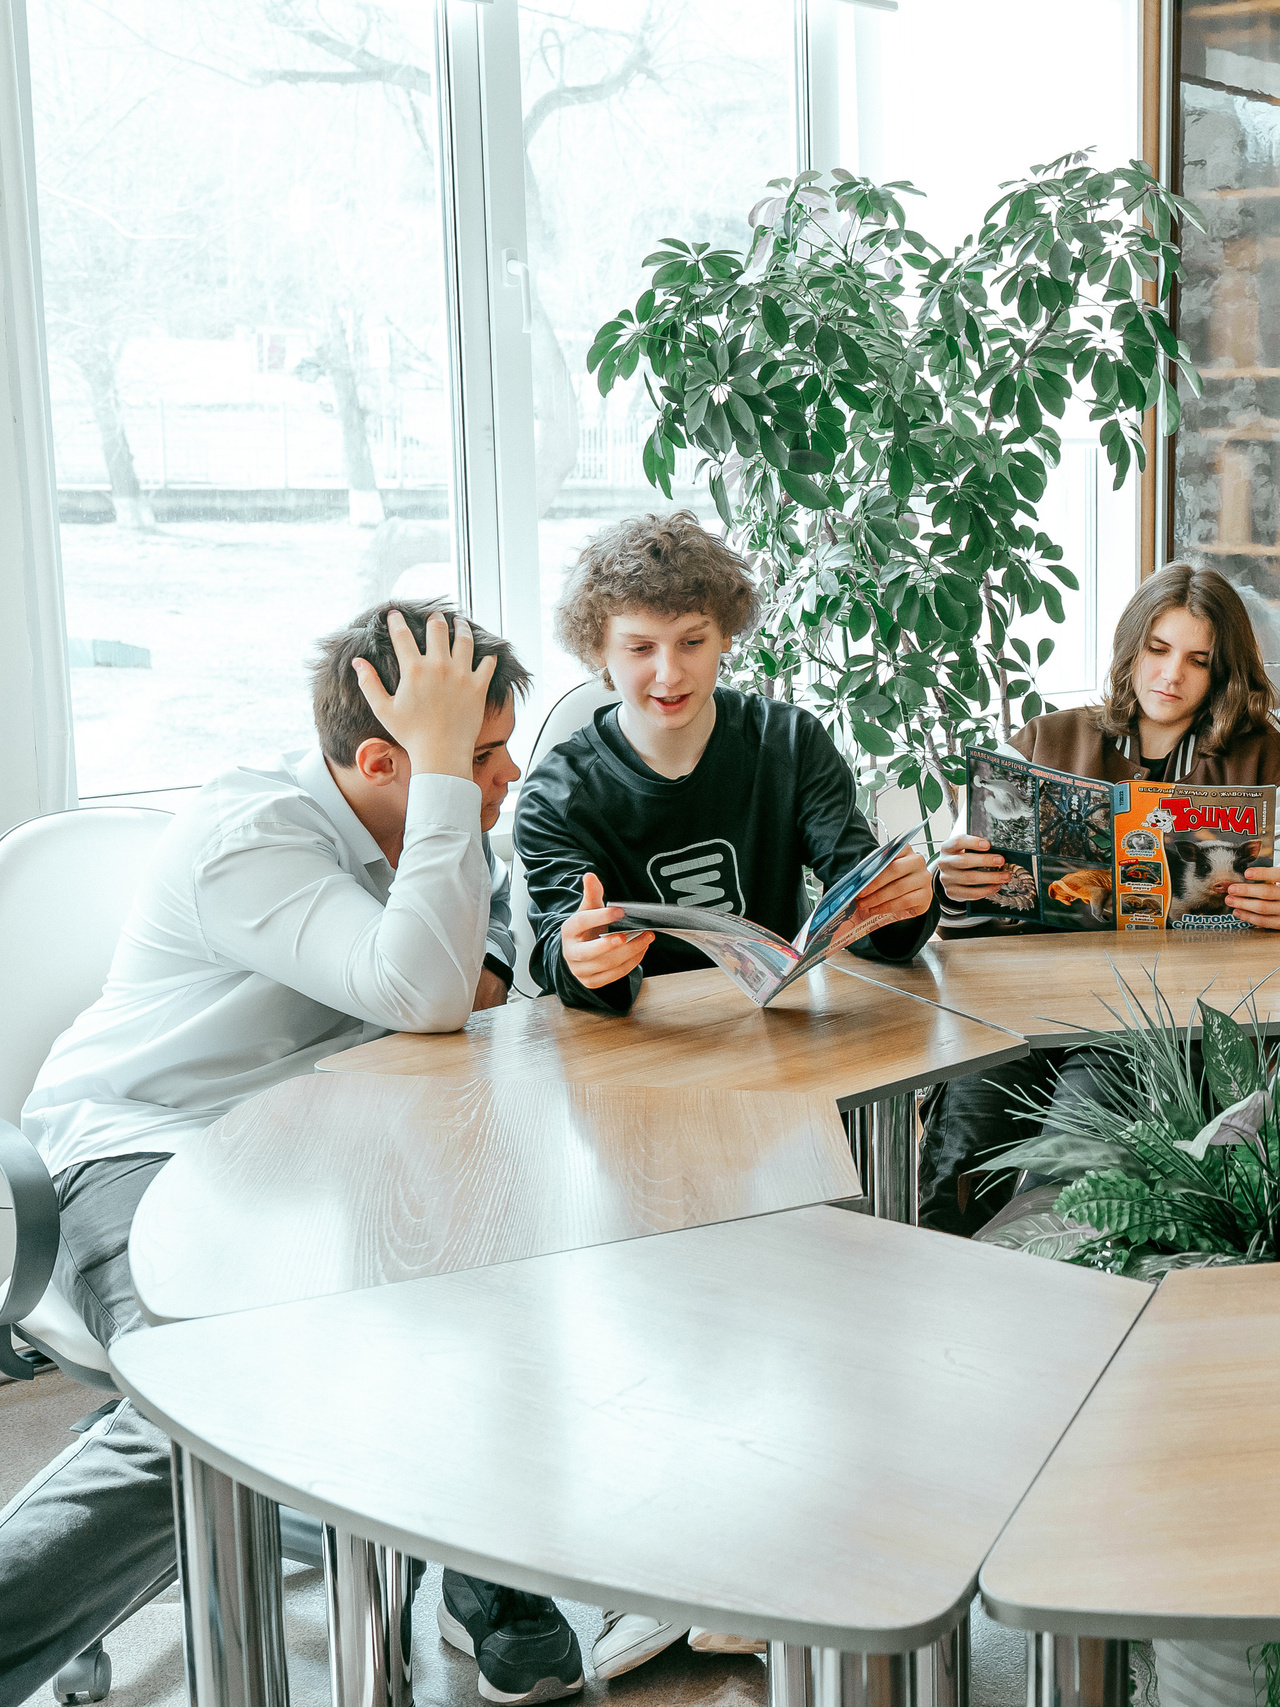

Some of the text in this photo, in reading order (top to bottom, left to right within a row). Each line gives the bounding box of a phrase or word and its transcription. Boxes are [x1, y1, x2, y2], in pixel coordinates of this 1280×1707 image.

[970, 751, 1000, 764] КОЛЛЕКЦИЯ
[1001, 760, 1028, 772] КАРТОЧЕК
[1177, 789, 1208, 797] ЖУРНАЛ
[1172, 920, 1251, 929] С ПЯТАЧКО
